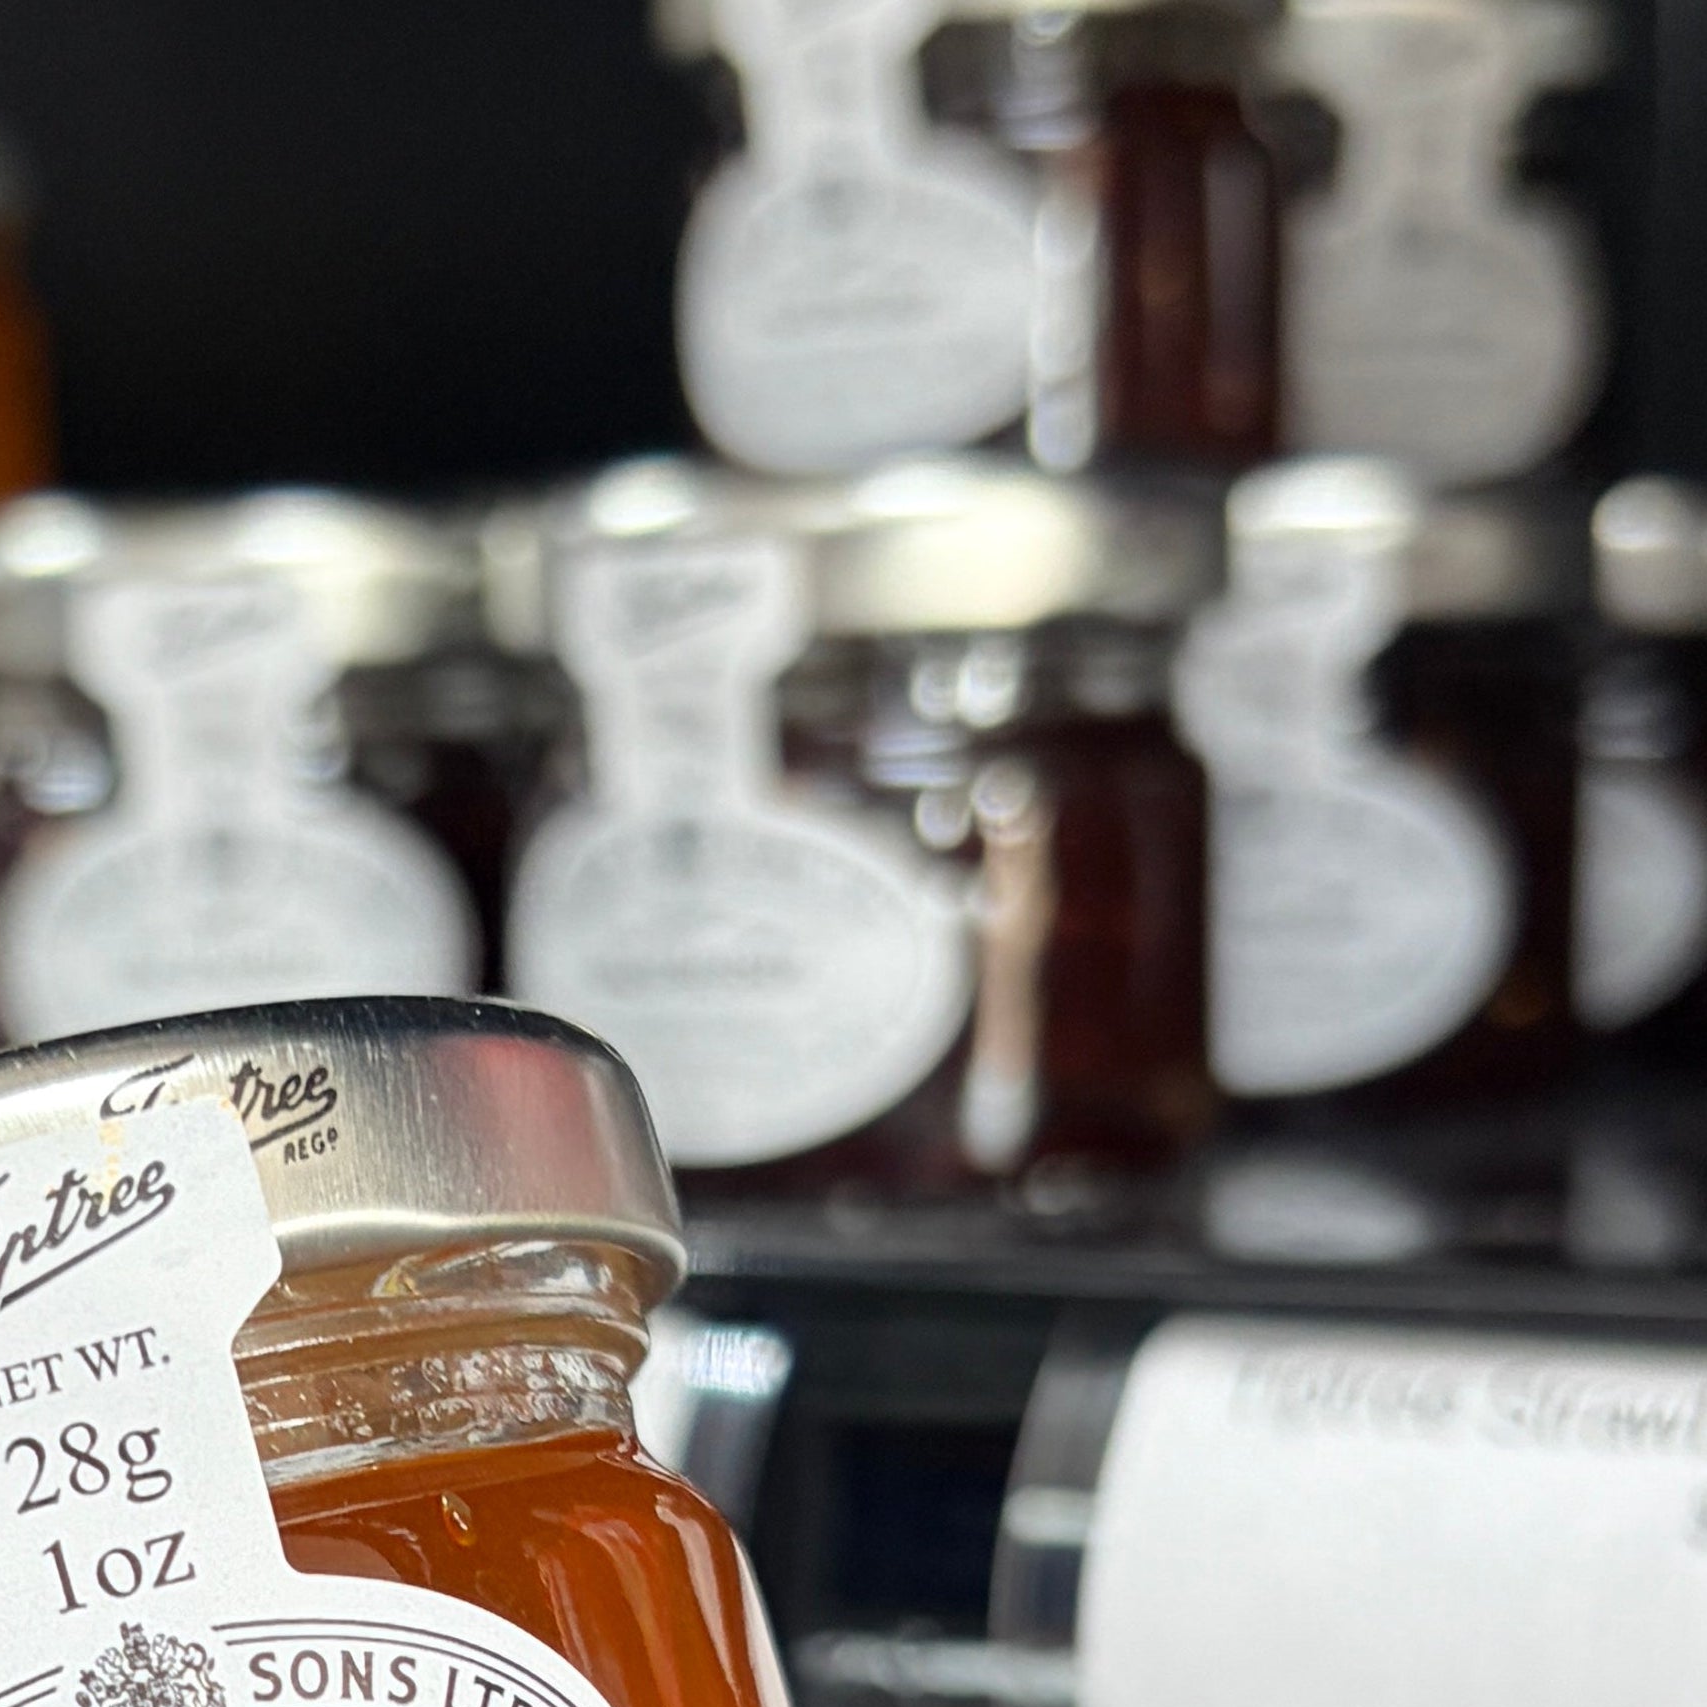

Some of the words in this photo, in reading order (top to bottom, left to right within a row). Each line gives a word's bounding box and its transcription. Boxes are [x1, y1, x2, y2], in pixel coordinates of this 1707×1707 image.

[73, 1328, 171, 1387] WT.
[3, 1420, 173, 1516] 28g
[41, 1528, 196, 1615] 1oz
[248, 1649, 419, 1703] SONS
